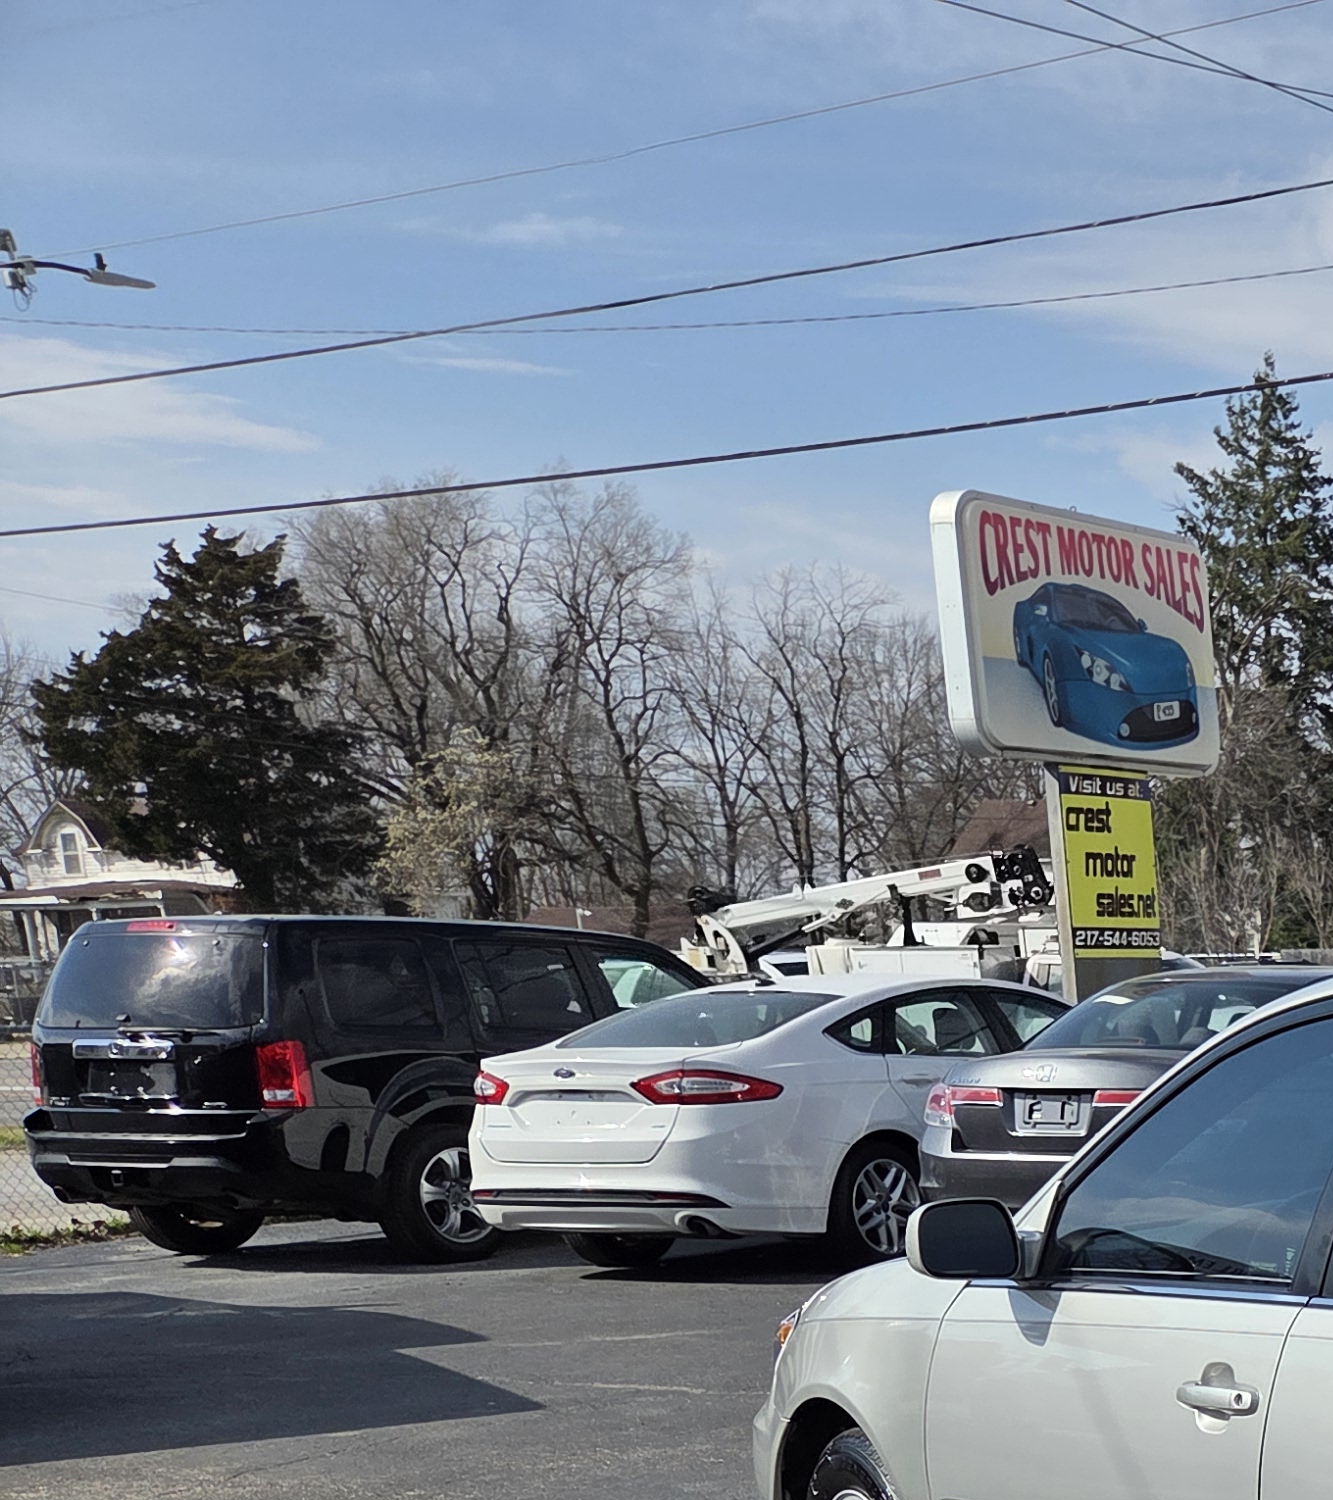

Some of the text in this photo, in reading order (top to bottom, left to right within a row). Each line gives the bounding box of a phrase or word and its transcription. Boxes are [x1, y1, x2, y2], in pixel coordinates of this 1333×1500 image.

[978, 509, 1205, 634] CREST MOTOR SALES
[1069, 775, 1102, 794] Visit
[1106, 781, 1124, 796] us
[1065, 800, 1112, 834] crest
[1084, 845, 1137, 879] motor
[1096, 885, 1157, 919] sales.net
[1075, 930, 1160, 946] 217-544-6053
